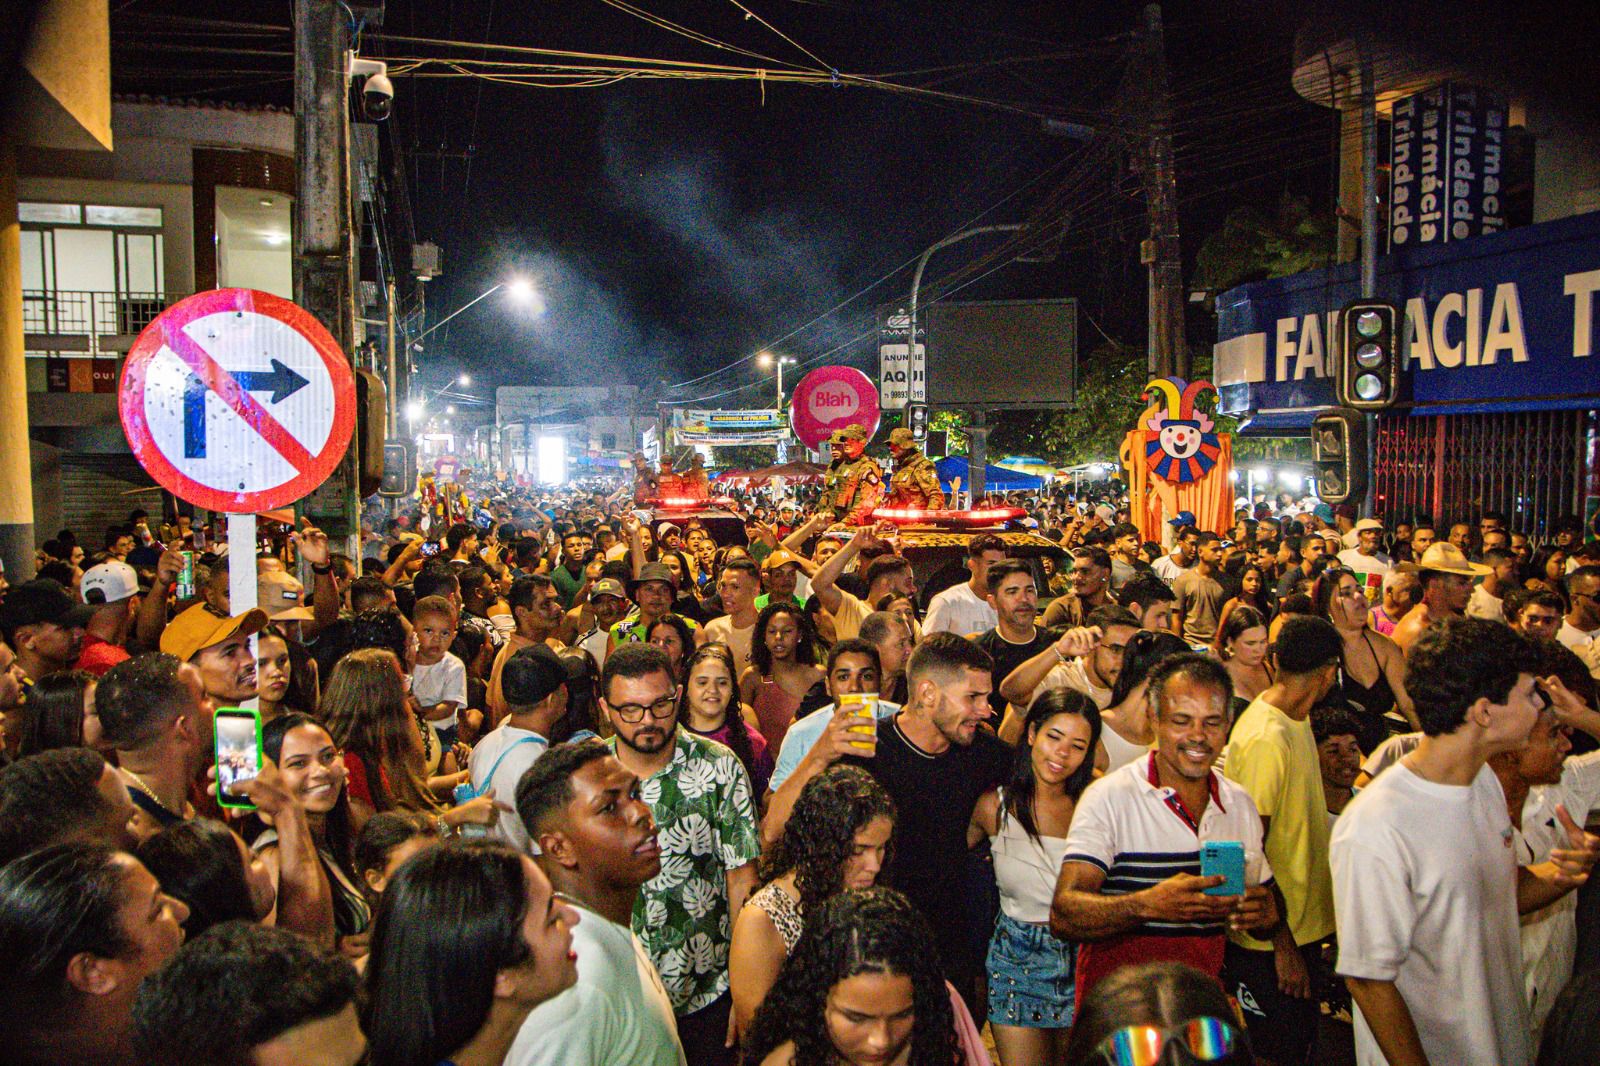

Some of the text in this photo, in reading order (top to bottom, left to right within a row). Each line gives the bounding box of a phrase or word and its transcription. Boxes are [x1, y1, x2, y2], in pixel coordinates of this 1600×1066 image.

[1275, 281, 1530, 382] FAACIA
[93, 371, 115, 380] OUI
[815, 391, 852, 407] Blah
